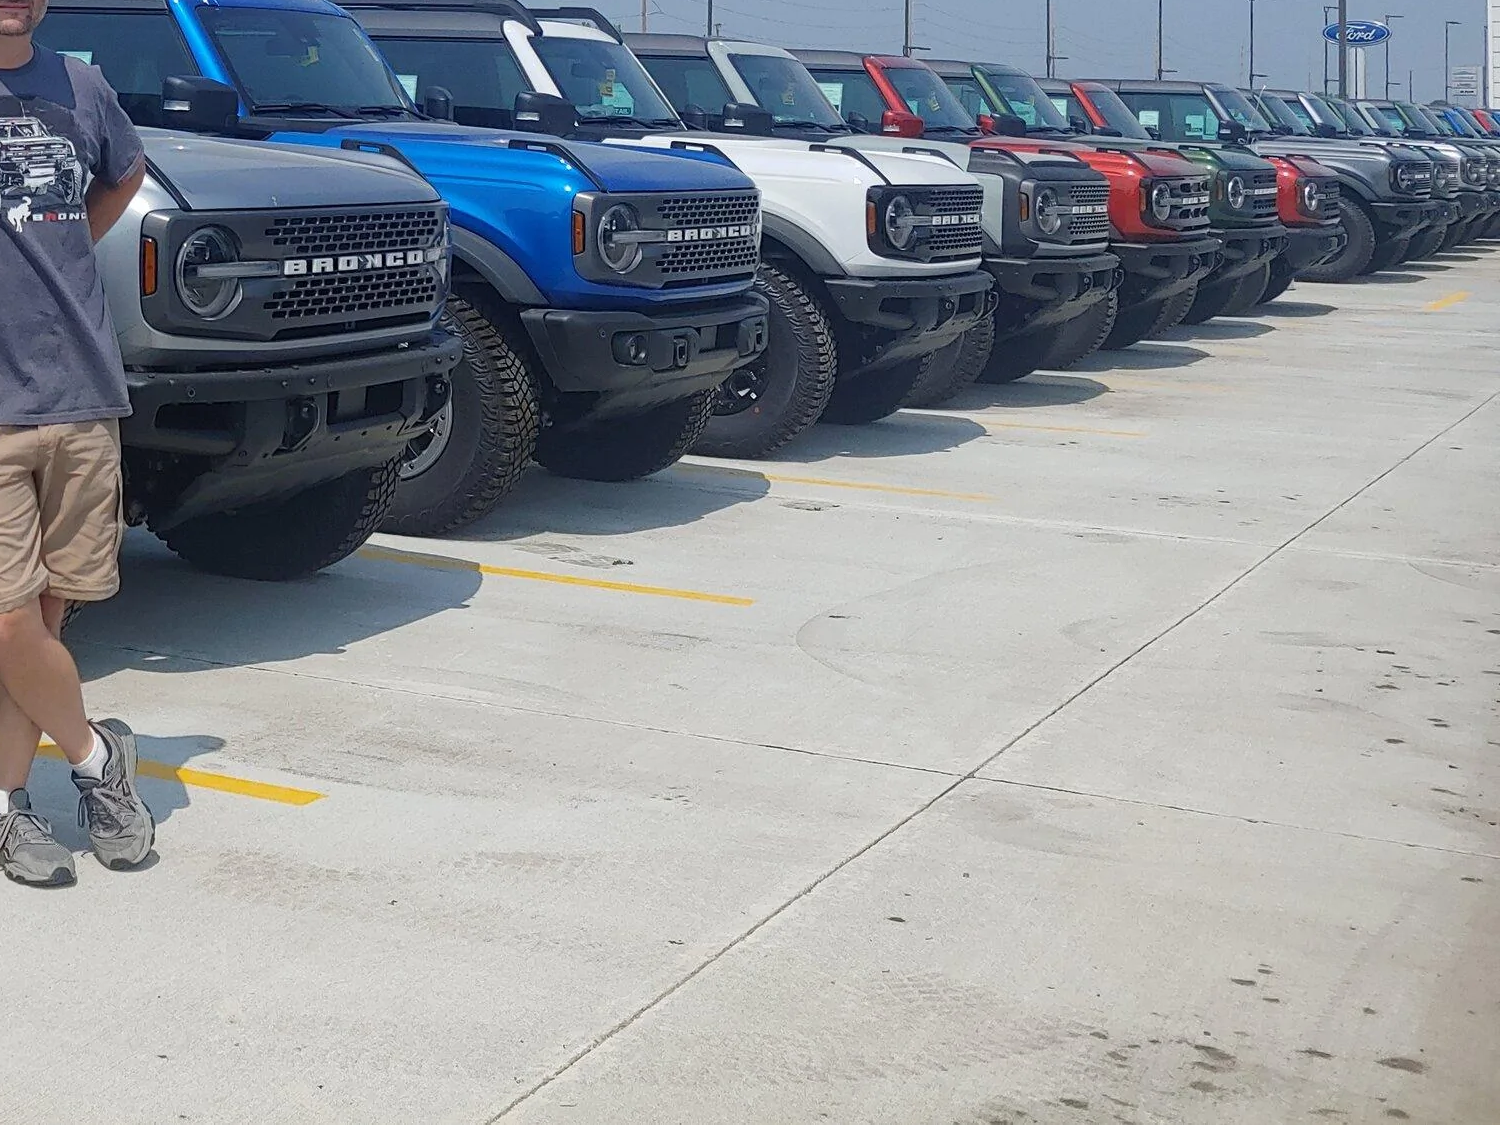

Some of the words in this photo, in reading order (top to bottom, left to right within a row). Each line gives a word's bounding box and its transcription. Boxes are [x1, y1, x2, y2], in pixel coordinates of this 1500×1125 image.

[1335, 24, 1376, 41] Ford
[32, 211, 87, 222] BRONC
[667, 224, 750, 242] BRONCO
[284, 249, 424, 276] BRONCO
